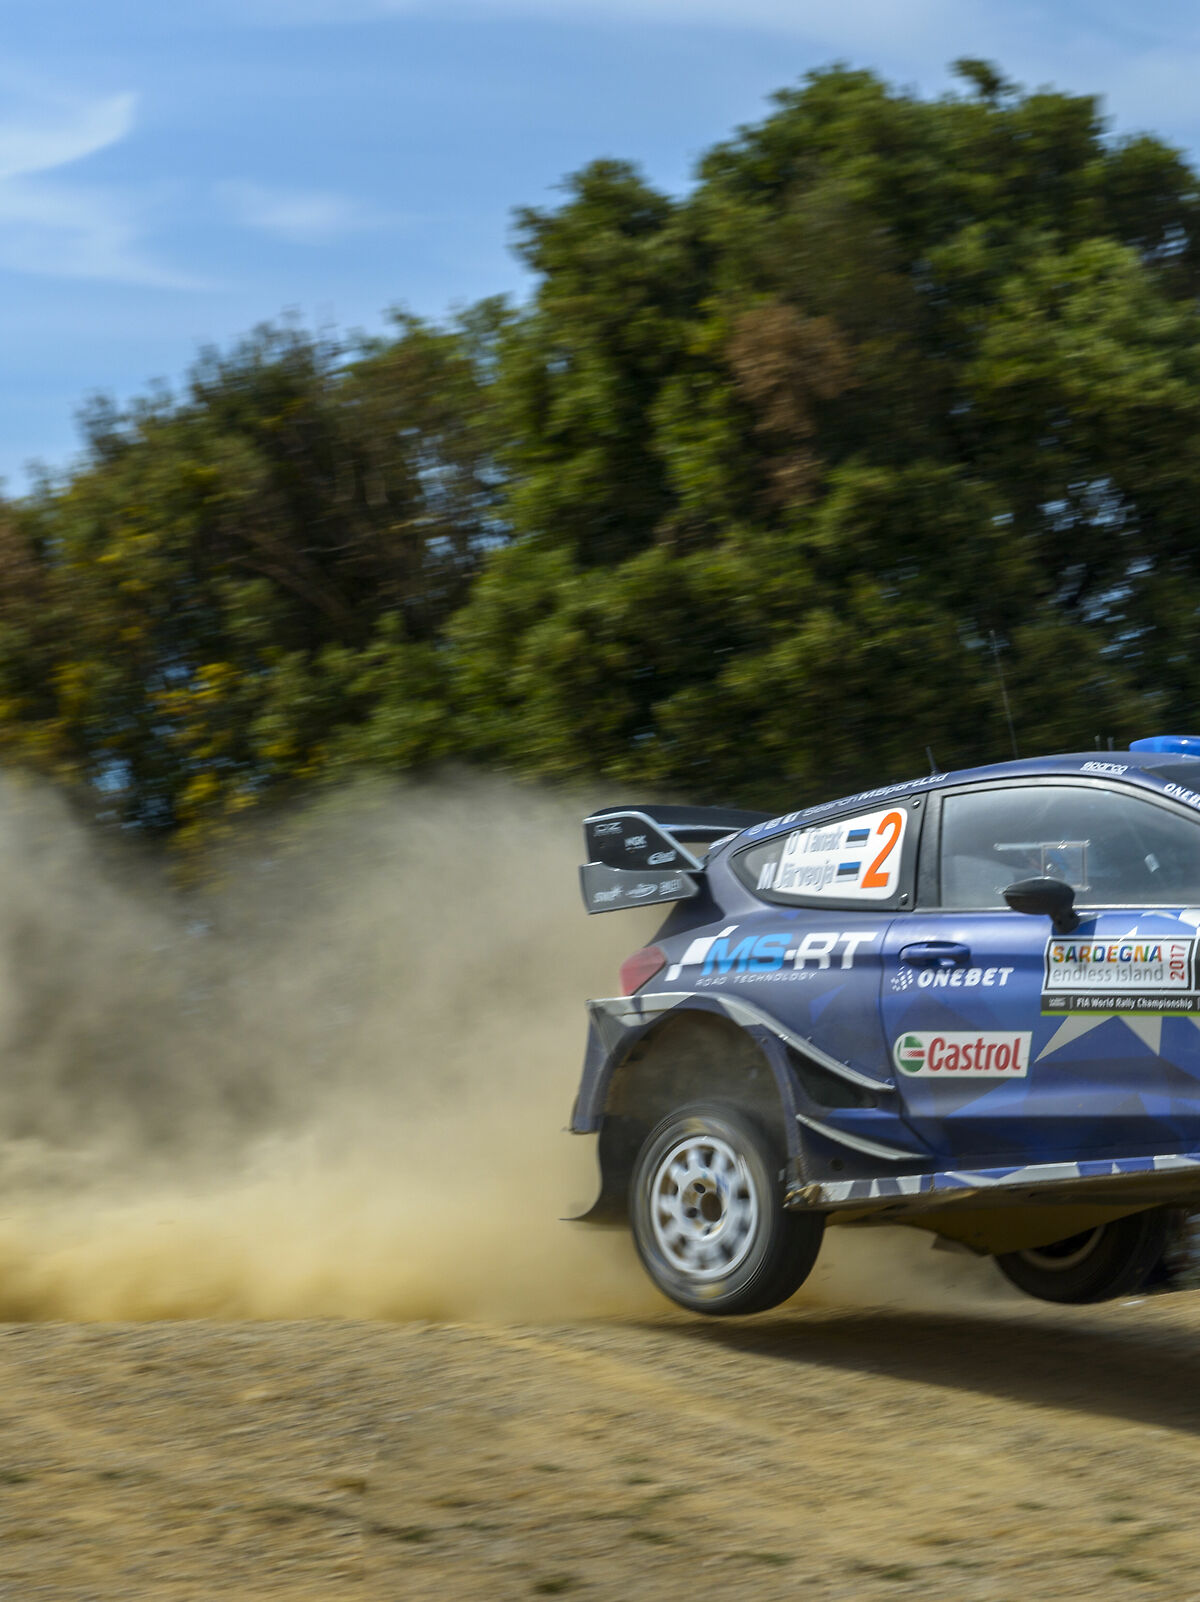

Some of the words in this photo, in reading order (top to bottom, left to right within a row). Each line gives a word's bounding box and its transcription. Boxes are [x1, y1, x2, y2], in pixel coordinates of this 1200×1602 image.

[860, 811, 903, 889] 2
[1052, 945, 1163, 964] SARDEGNA
[1169, 944, 1187, 981] 2017
[917, 967, 1015, 988] ONEBET
[1052, 964, 1113, 983] endless
[1114, 963, 1164, 982] island
[1091, 997, 1114, 1008] World
[1137, 997, 1193, 1010] Championship
[928, 1037, 1022, 1071] Castrol
